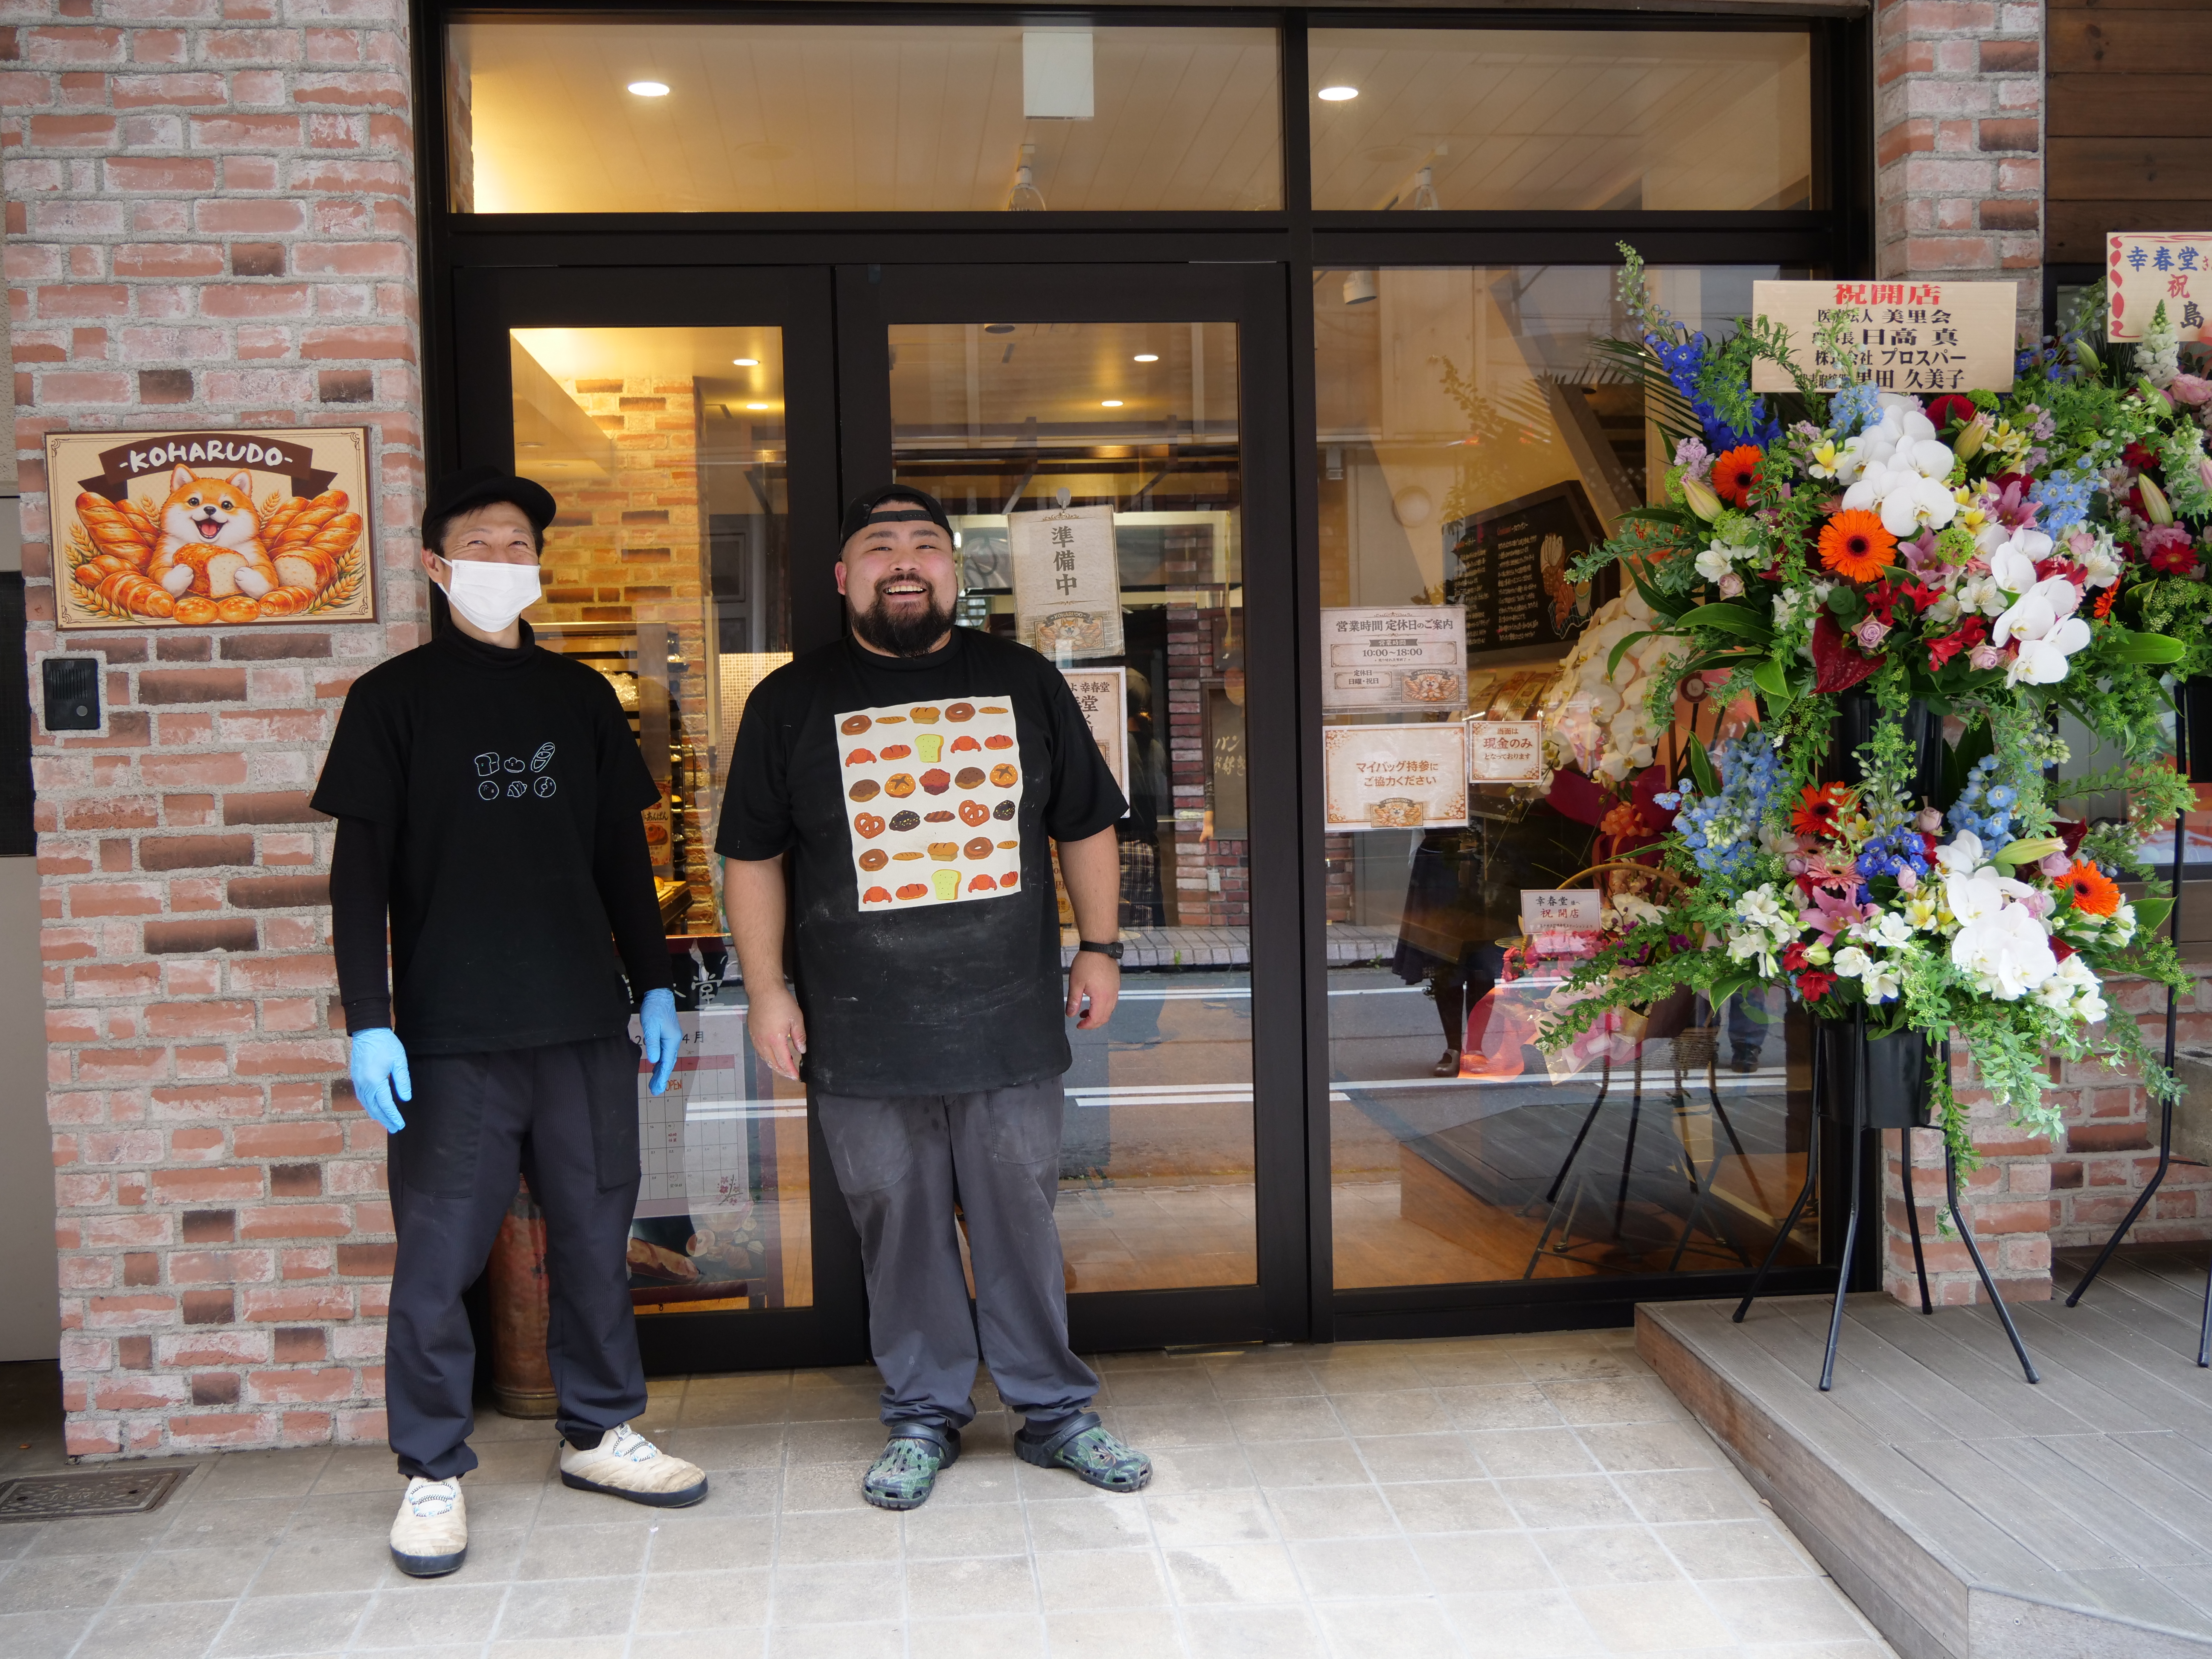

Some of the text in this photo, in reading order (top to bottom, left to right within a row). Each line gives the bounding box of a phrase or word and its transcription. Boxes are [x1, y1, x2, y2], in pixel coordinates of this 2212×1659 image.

[2167, 274, 2190, 299] 祝
[1833, 284, 1941, 305] 祝開店
[1882, 309, 1951, 324] 美里会
[2180, 301, 2204, 329] 島
[1932, 328, 1959, 346] 真
[1881, 347, 1966, 366] プロスパー
[1904, 368, 1965, 389] 久美子
[1051, 526, 1077, 596] 準備中
[1336, 620, 1383, 632] 営業時間
[1385, 619, 1453, 631] 定休日のご案内
[1080, 681, 1110, 693] 幸春堂
[1483, 737, 1533, 749] 現金のみ
[1356, 760, 1439, 773] マイバッグ持参に
[1364, 775, 1436, 786] ご協力ください
[1535, 895, 1568, 906] 幸春堂
[665, 1079, 682, 1091] OPEN
